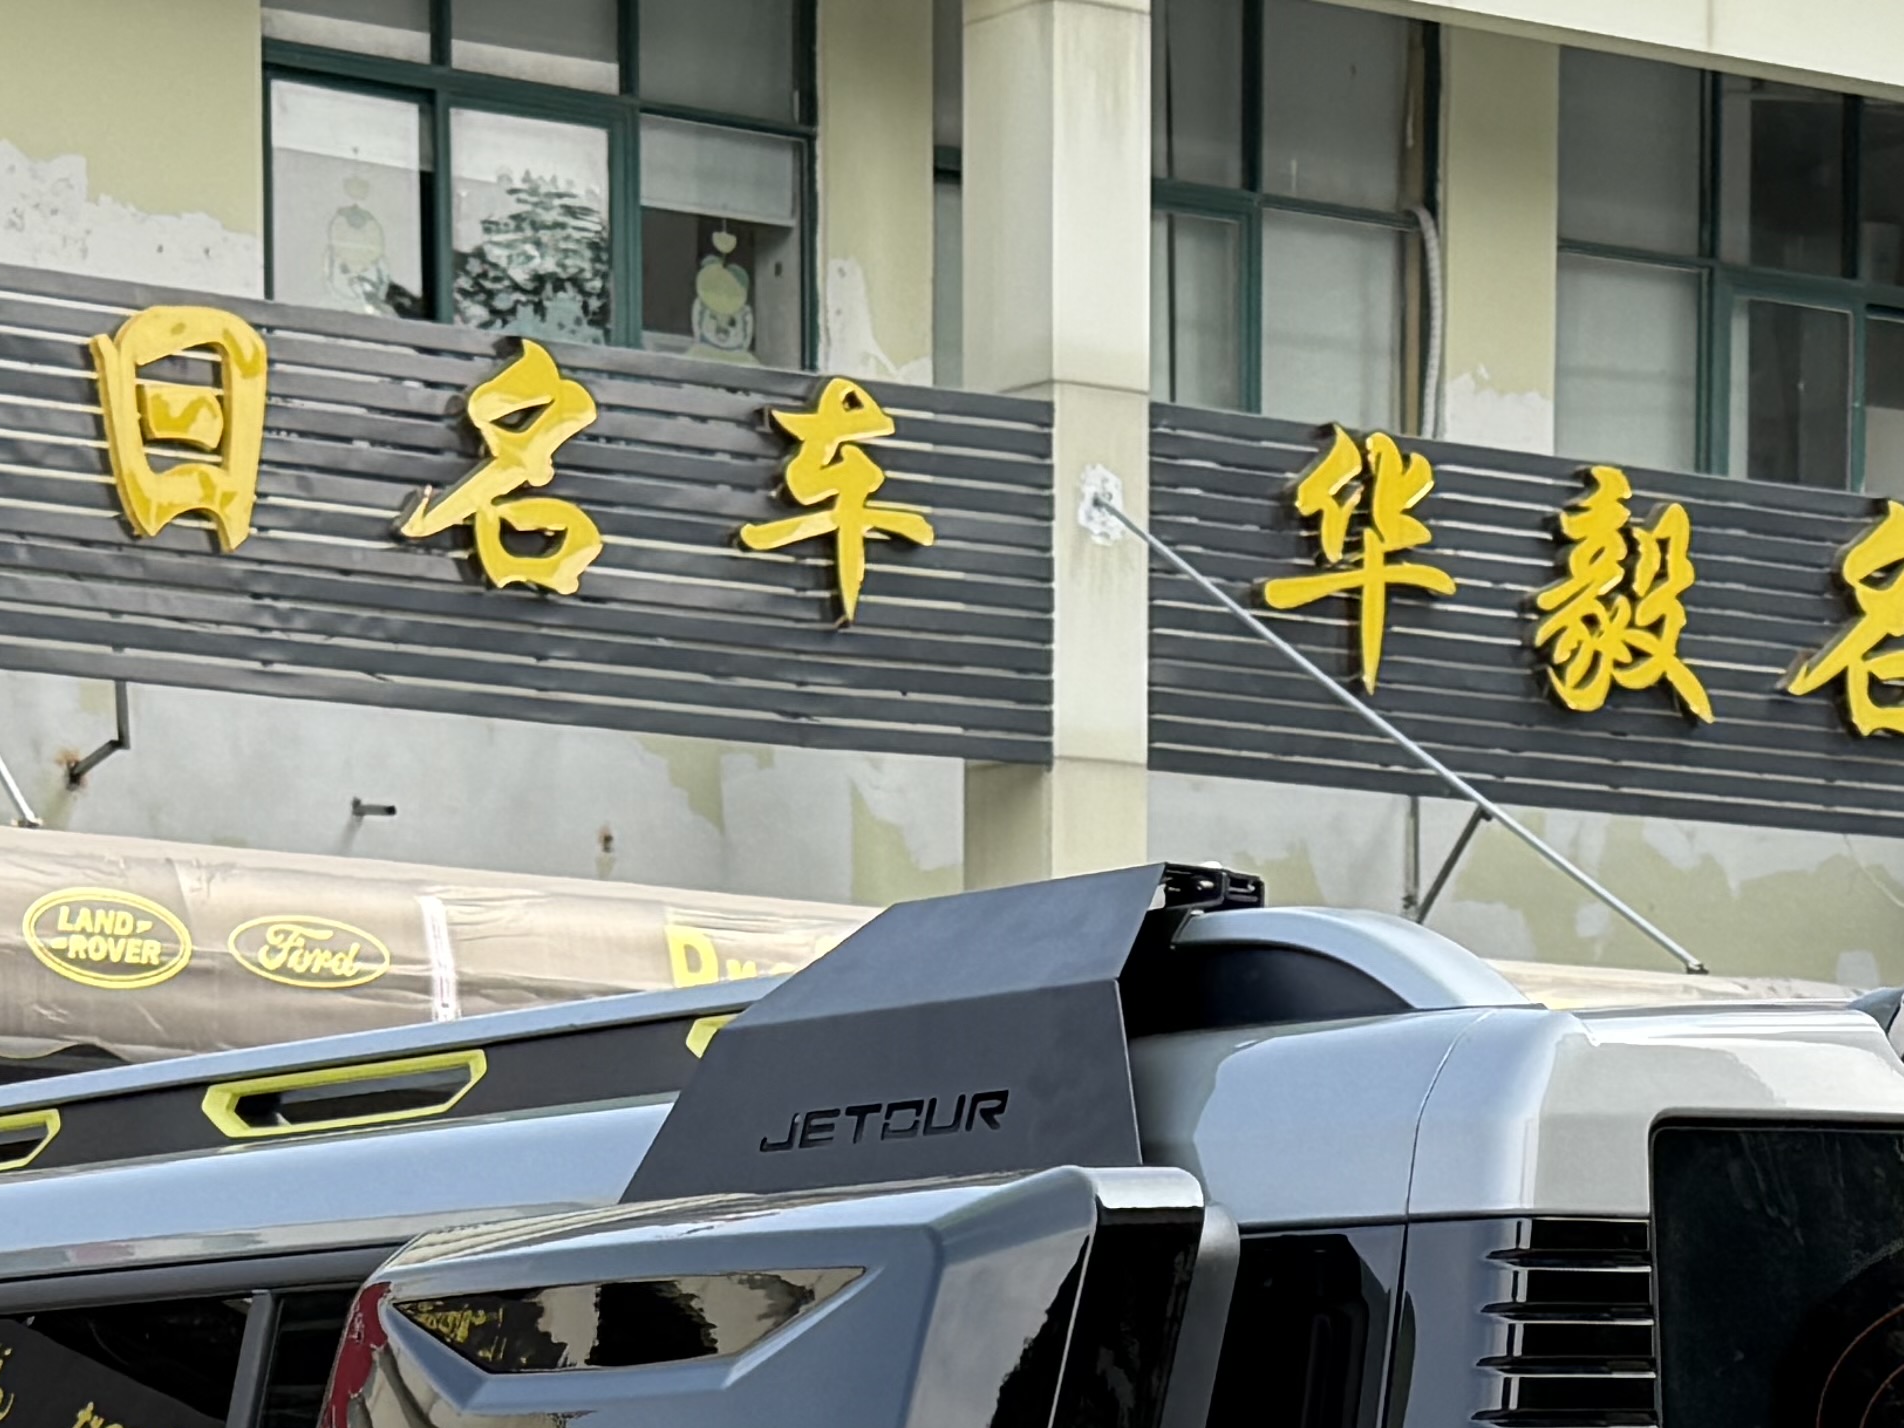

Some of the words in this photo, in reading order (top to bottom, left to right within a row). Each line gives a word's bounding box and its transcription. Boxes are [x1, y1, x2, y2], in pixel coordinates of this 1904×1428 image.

[57, 906, 134, 935] LAND
[67, 934, 162, 966] ROVER
[258, 924, 361, 977] Ford
[760, 1089, 1010, 1153] JETOUR
